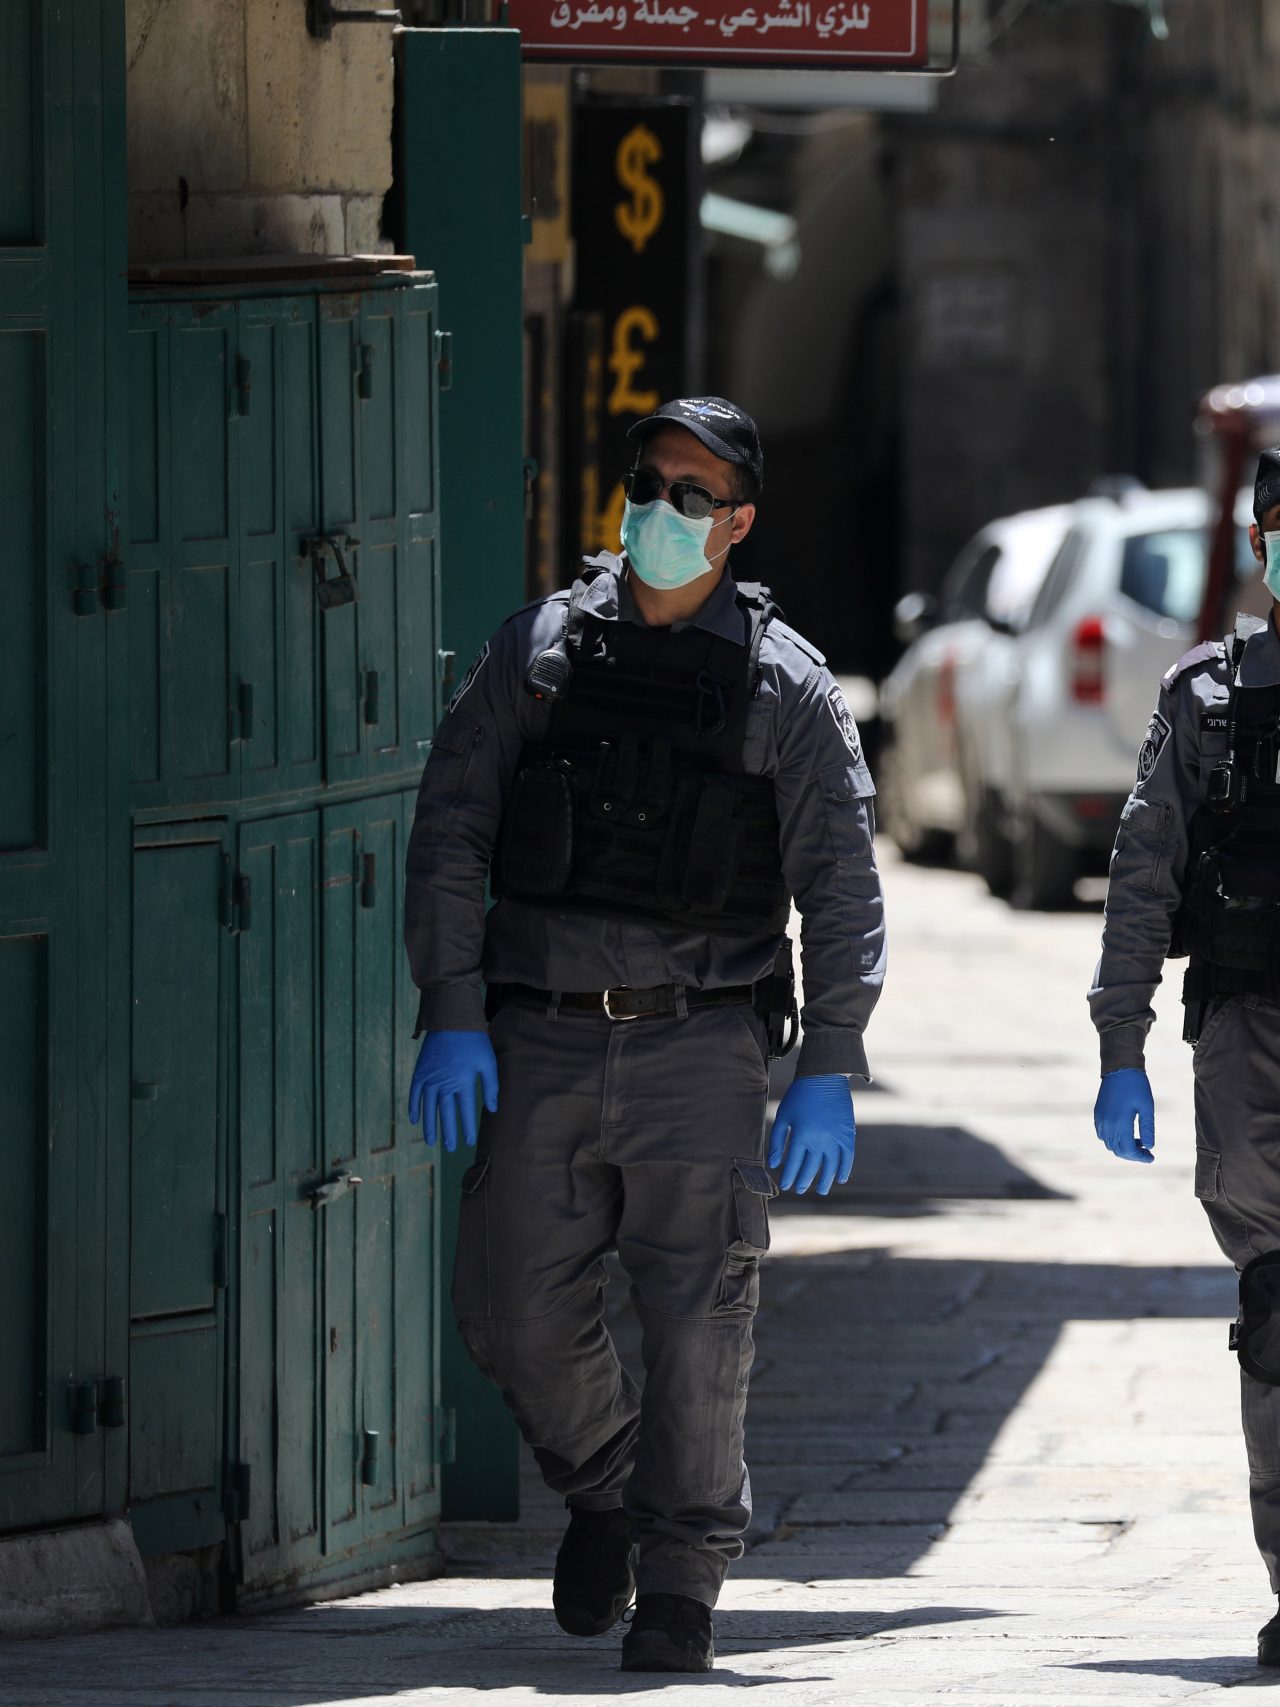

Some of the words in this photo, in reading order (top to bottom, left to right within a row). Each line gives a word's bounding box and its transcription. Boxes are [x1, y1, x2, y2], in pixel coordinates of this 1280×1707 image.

[550, 0, 626, 31] ومفرق
[633, 0, 699, 32] جملة
[721, 0, 809, 36] الشرعي
[817, 2, 870, 38] للزي
[615, 124, 664, 253] $
[609, 306, 659, 416] £
